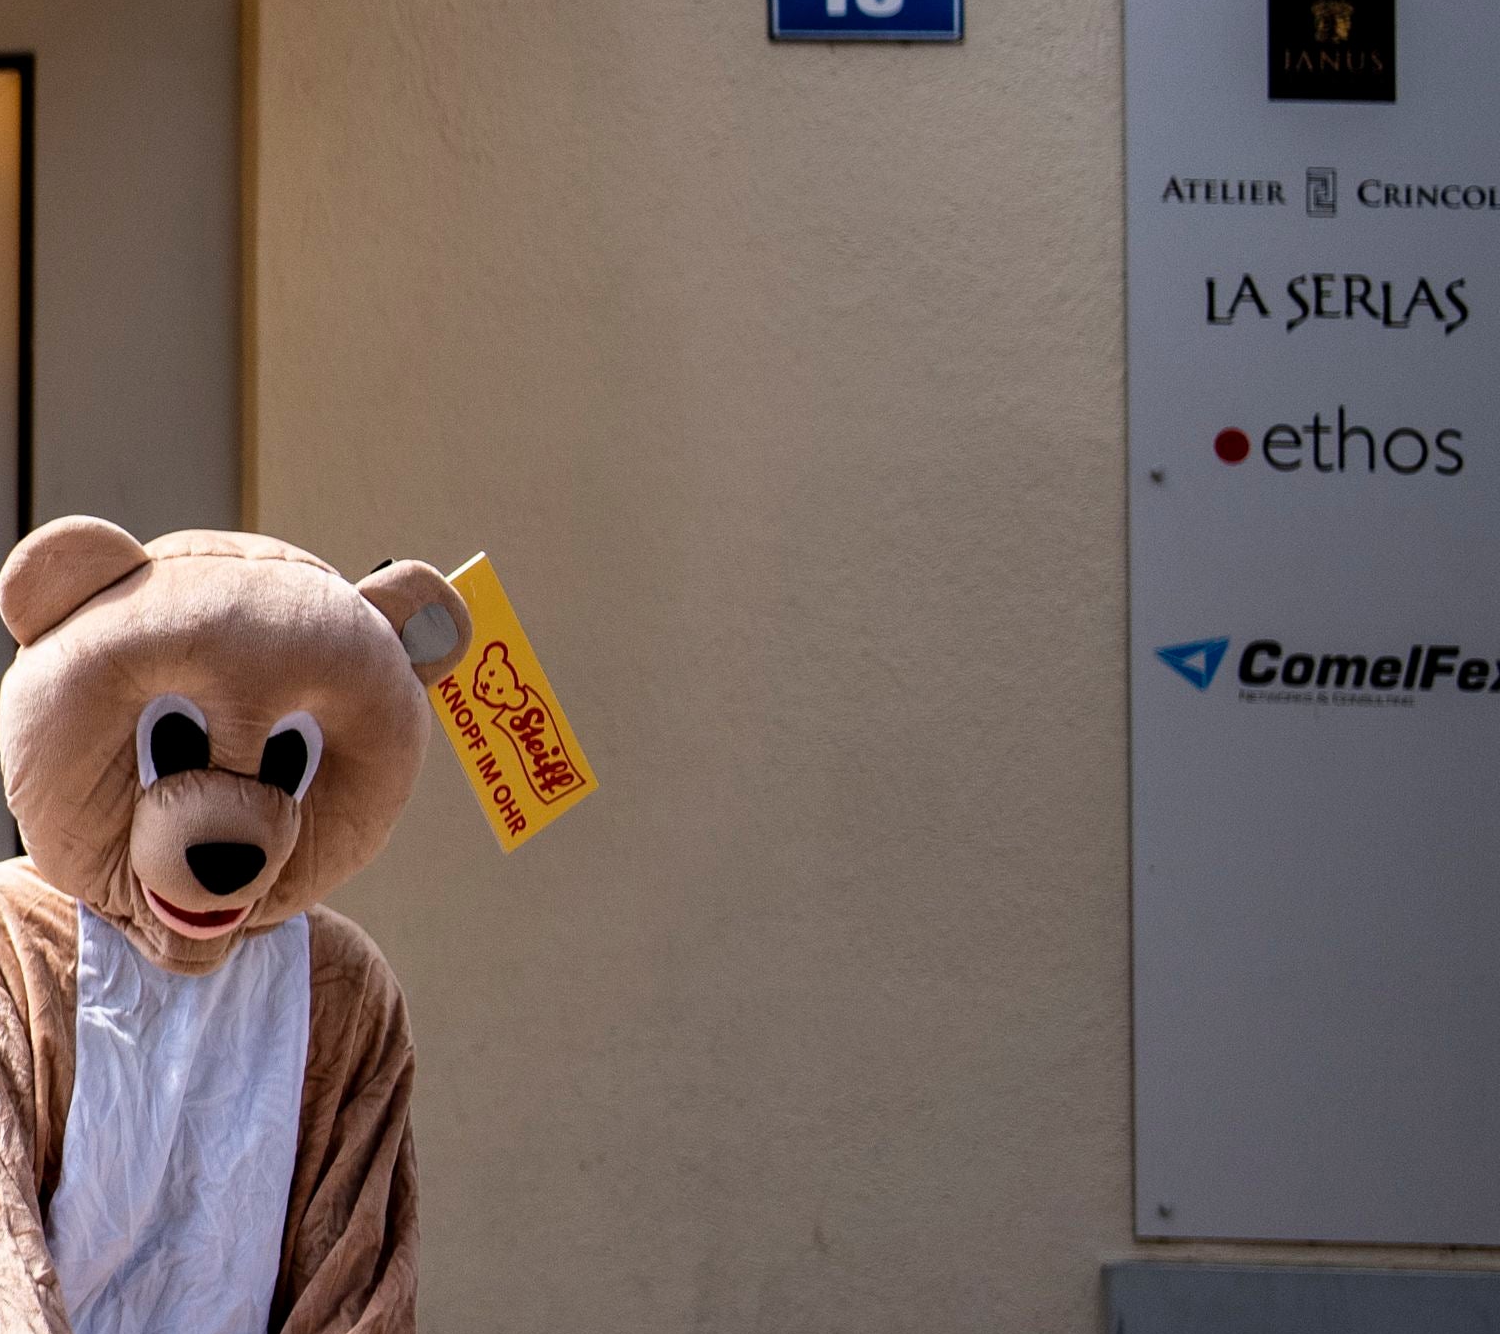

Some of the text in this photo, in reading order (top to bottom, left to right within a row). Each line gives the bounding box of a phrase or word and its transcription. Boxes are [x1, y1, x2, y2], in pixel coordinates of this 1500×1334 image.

[1205, 273, 1469, 334] LA SERLAS
[1262, 403, 1464, 477] ethos
[438, 675, 527, 837] KNOPF IM OHR
[509, 707, 575, 795] Steiff
